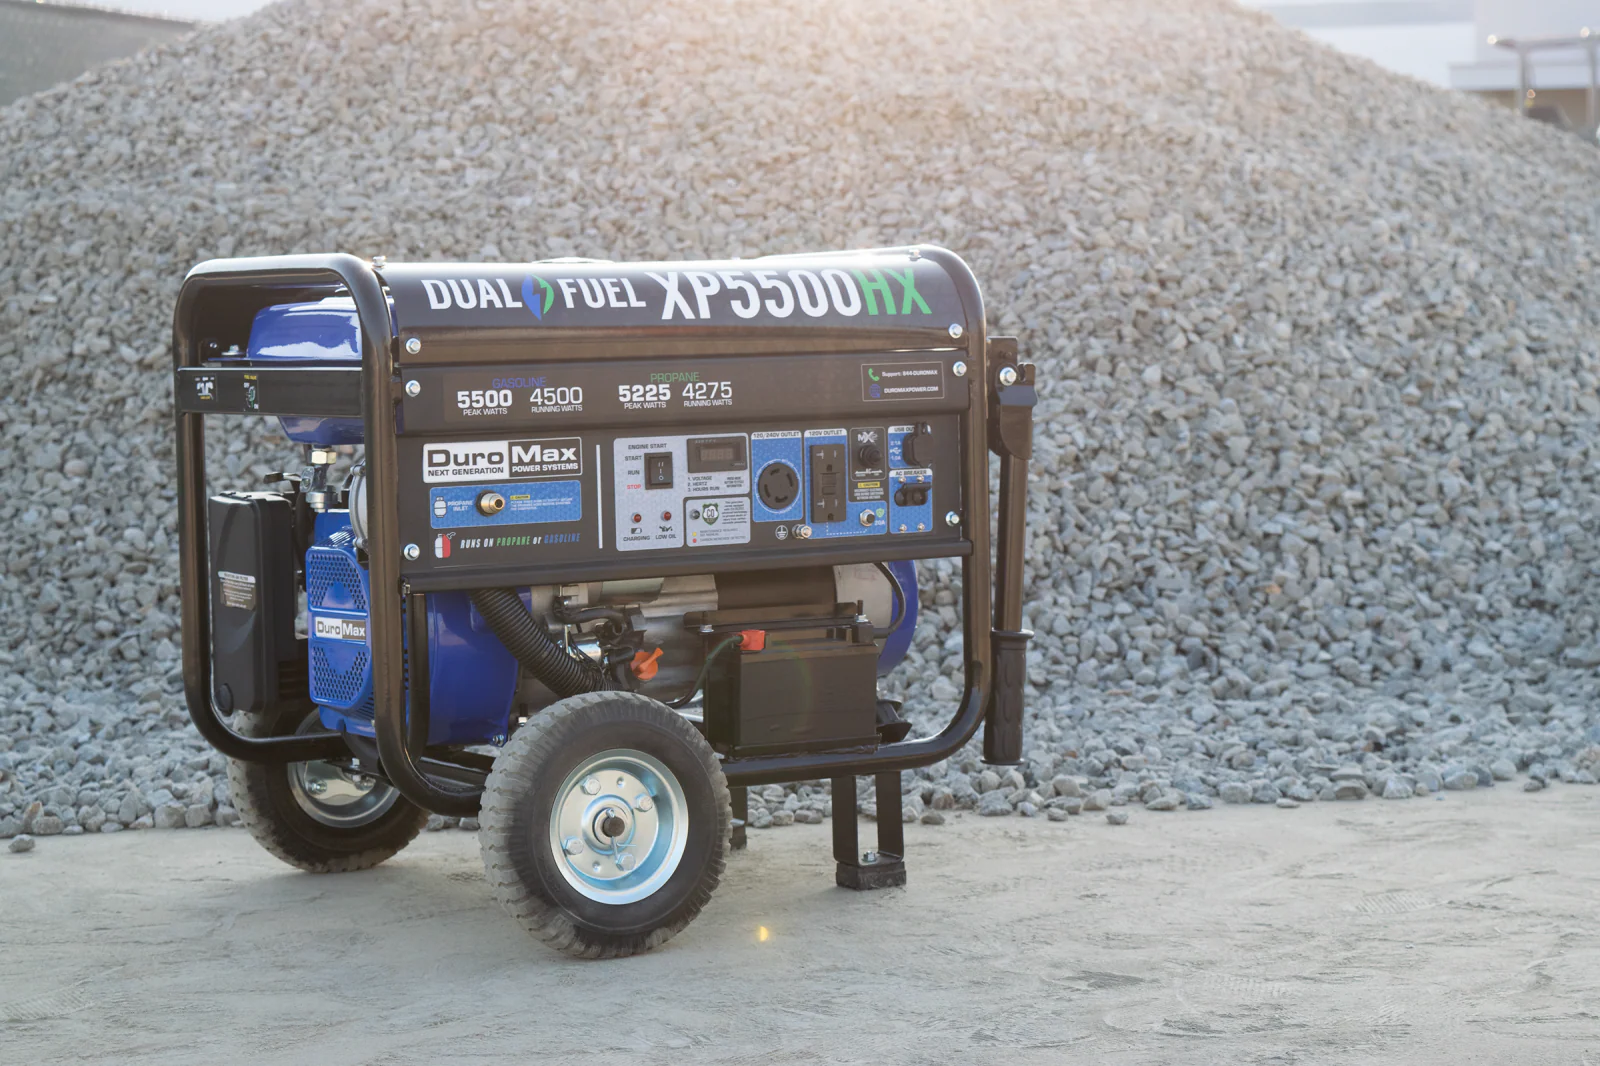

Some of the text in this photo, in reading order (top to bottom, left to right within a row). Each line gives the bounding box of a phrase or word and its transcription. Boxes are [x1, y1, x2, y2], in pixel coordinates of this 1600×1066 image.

[421, 278, 647, 310] DUAL FUEL
[644, 267, 933, 320] XP5500HX
[492, 377, 546, 389] GASOLINE
[650, 372, 700, 383] PROPANE
[618, 384, 671, 403] 5225
[682, 381, 732, 400] 4275
[883, 386, 939, 394] DUROMAXPOWER.COM
[457, 389, 513, 409] 5500
[529, 386, 583, 406] 4500
[624, 401, 667, 410] PEAK WATTS
[683, 398, 733, 408] RUNNING WATTS
[483, 407, 508, 415] WATTS
[531, 404, 583, 414] RUNNING WATTS
[428, 466, 504, 477] NEXT GENERATION
[511, 462, 579, 473] POWER SYSTEMS
[706, 508, 715, 518] CO
[460, 538, 481, 549] RUNS
[483, 537, 494, 547] ON
[496, 535, 531, 547] PROPANE
[543, 532, 581, 544] GASOLINE
